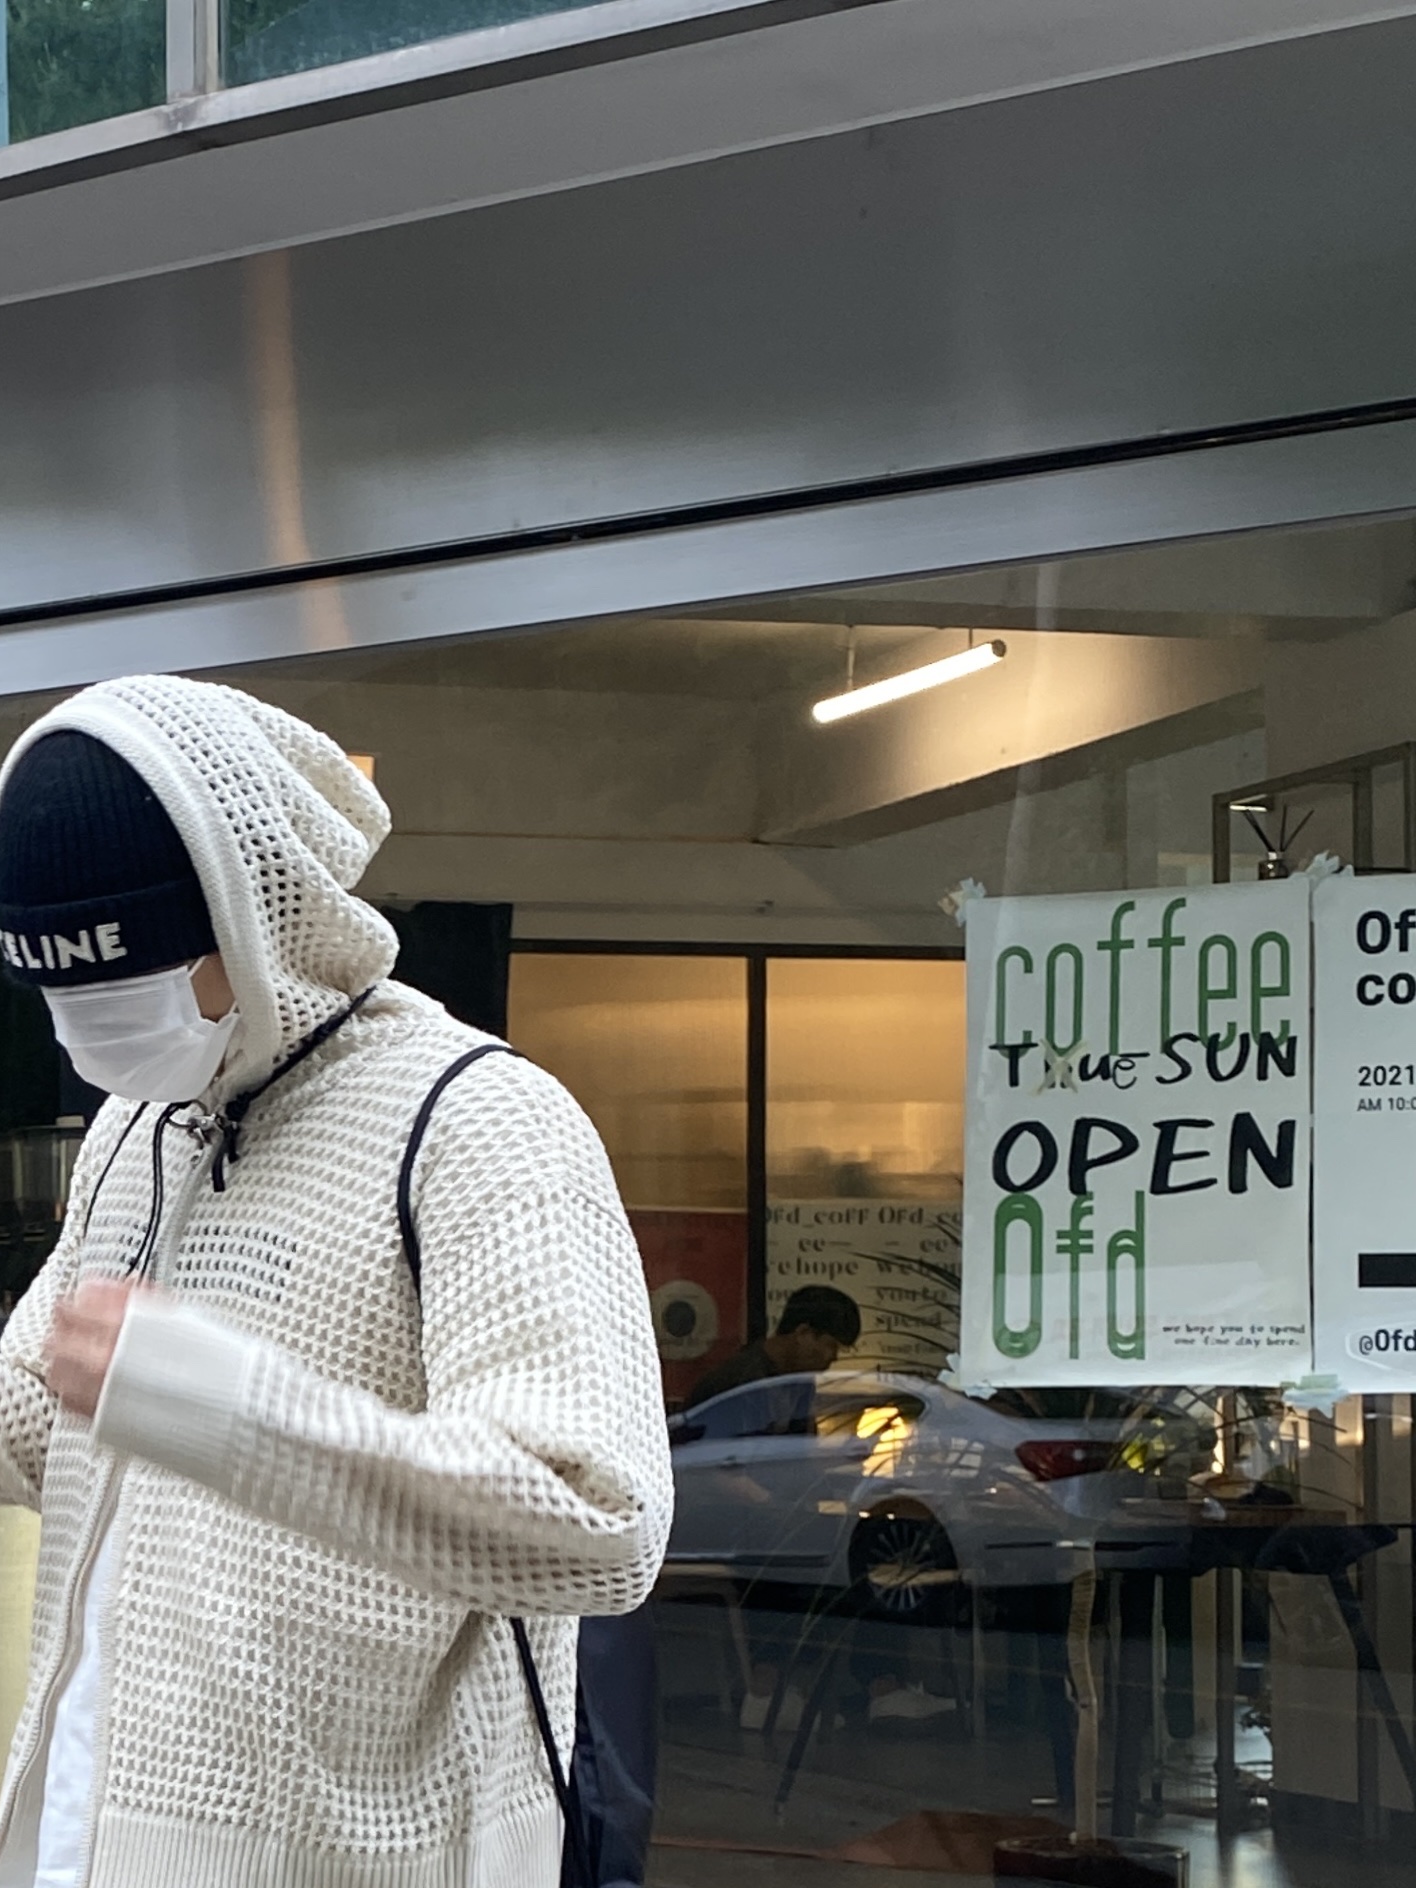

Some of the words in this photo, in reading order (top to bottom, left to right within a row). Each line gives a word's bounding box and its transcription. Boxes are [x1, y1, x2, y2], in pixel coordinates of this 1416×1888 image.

[995, 897, 1291, 1060] coffee
[1155, 1032, 1298, 1083] SUN
[1358, 1064, 1414, 1087] 2021
[1357, 1097, 1382, 1111] AM
[992, 1112, 1297, 1196] OPEN
[992, 1190, 1146, 1360] Ofd
